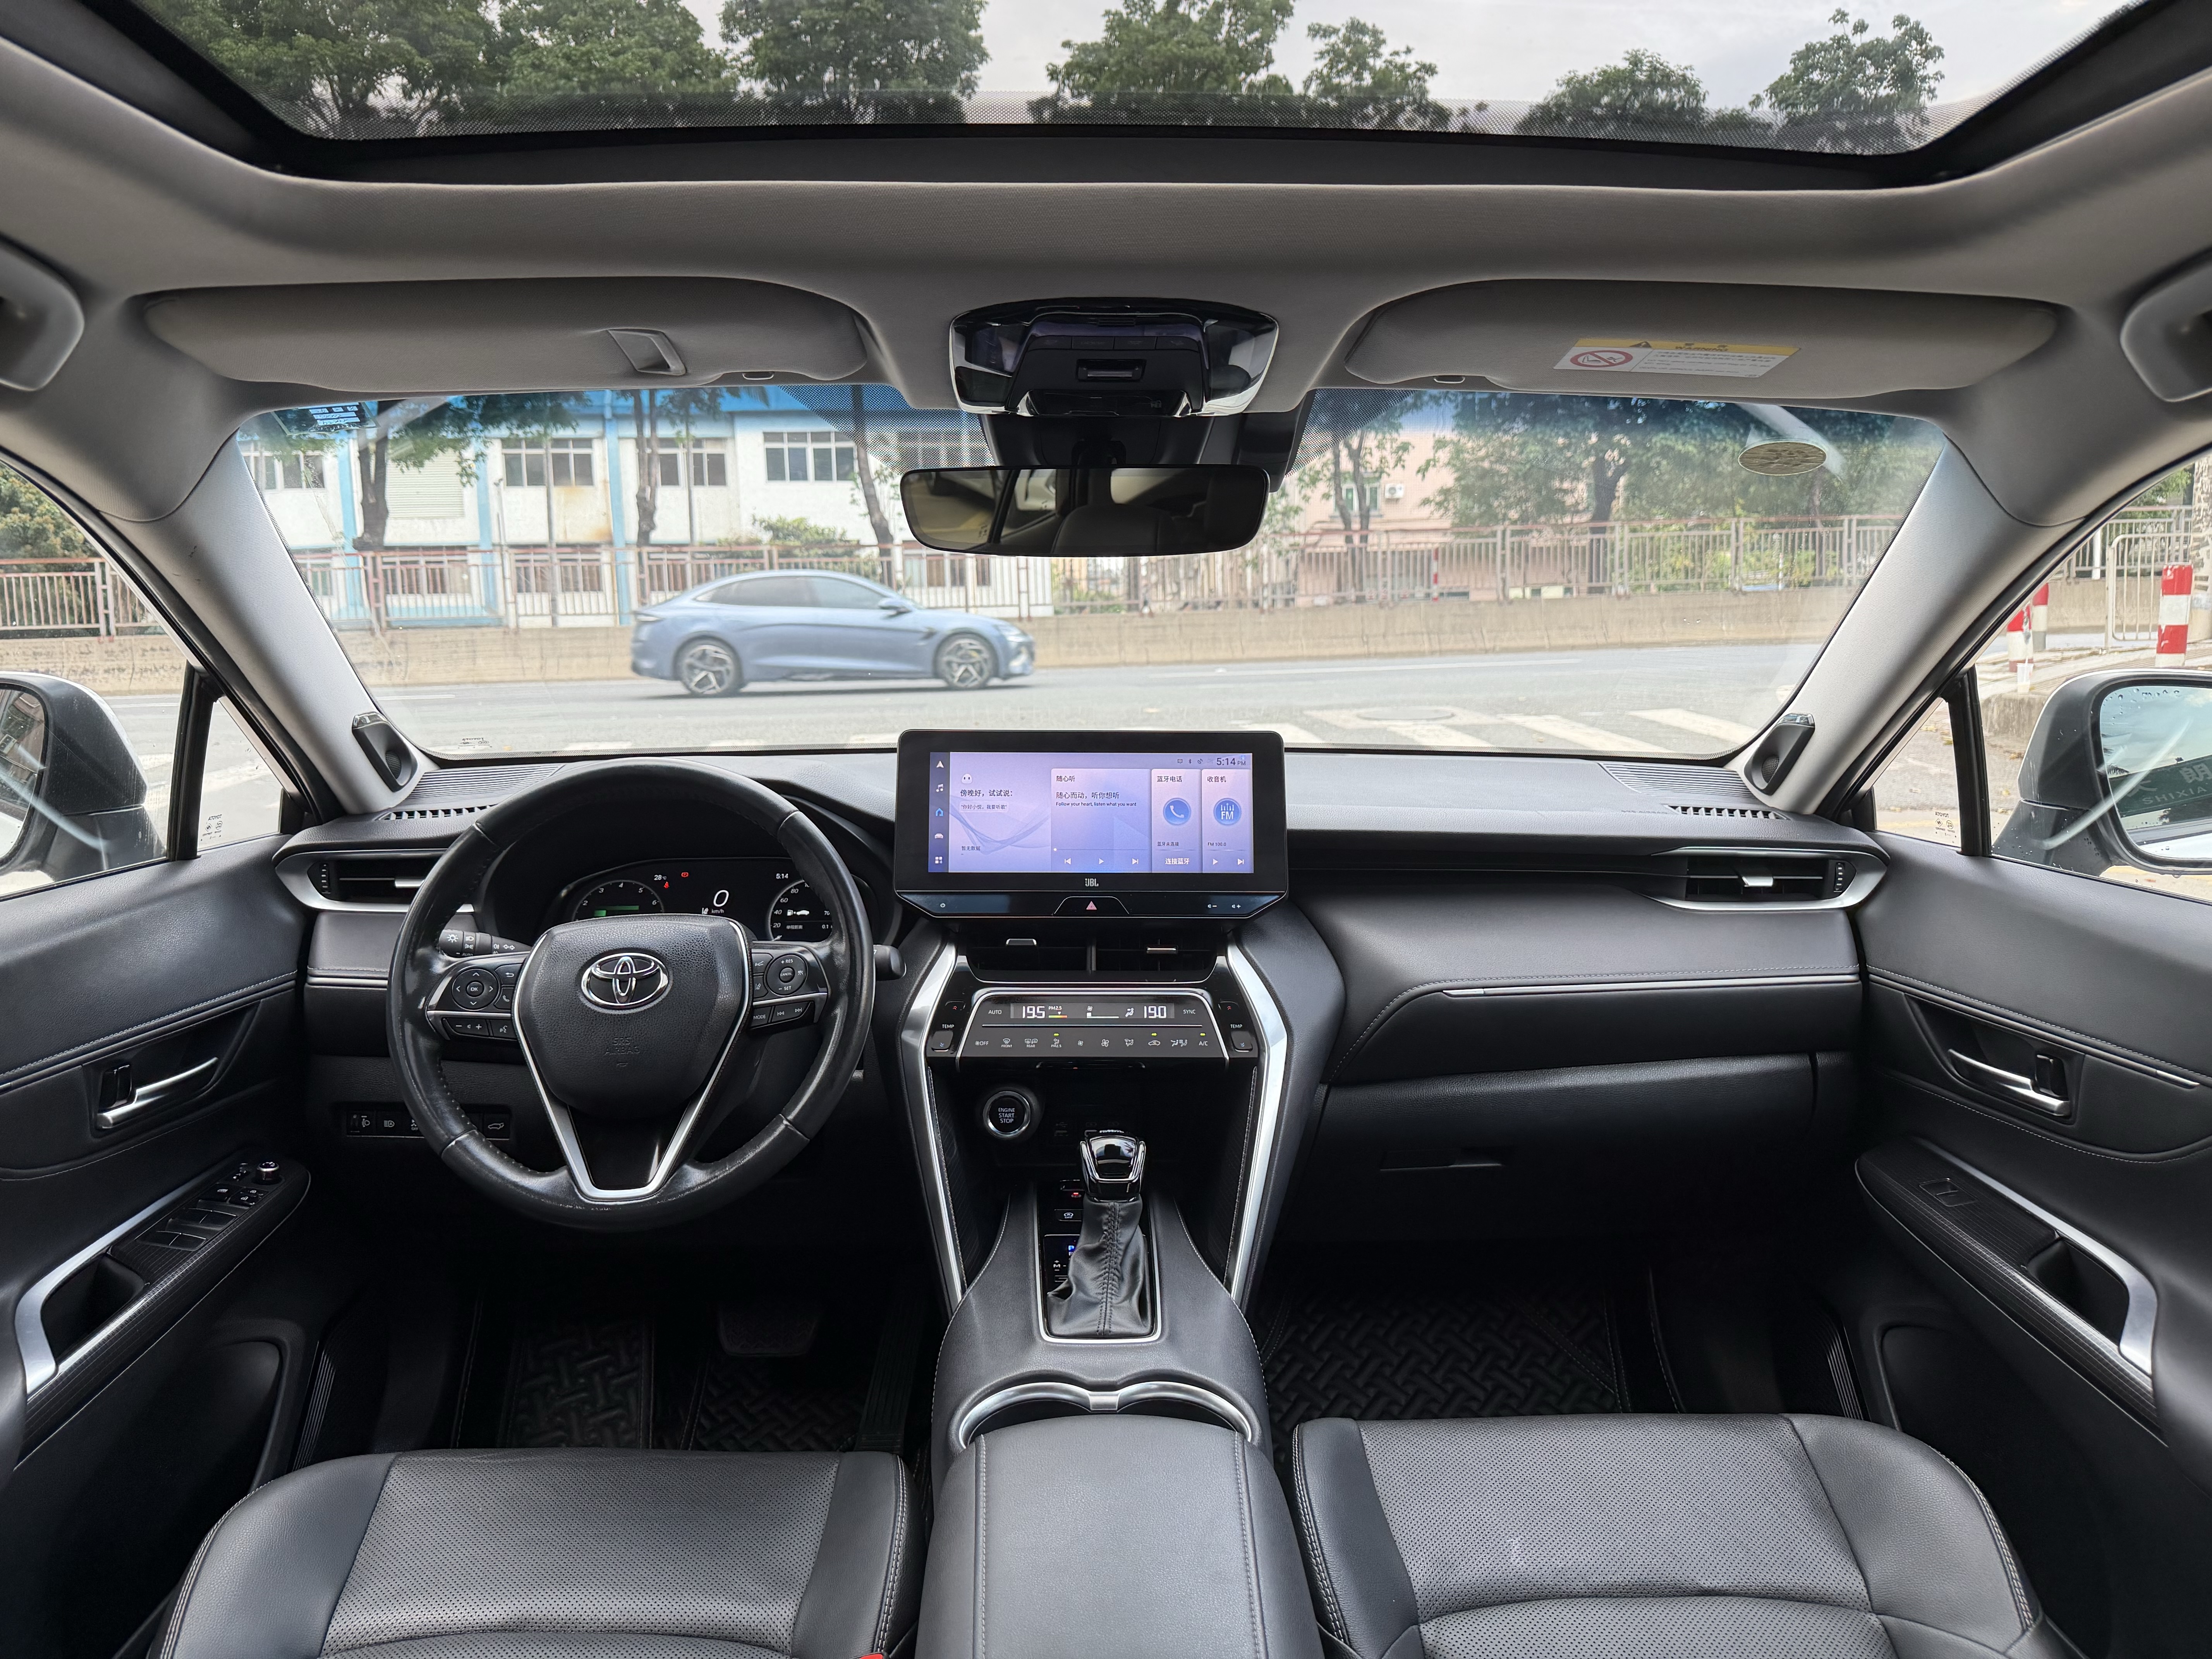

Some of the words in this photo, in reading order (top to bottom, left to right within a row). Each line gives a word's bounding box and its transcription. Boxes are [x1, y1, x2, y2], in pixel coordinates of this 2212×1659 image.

[1216, 757, 1236, 766] 5:14
[2142, 786, 2207, 804] SHIXIA
[1221, 811, 1234, 820] FM
[1085, 878, 1099, 887] JBL
[713, 890, 729, 907] 0
[1022, 1006, 1045, 1018] 19.5
[1144, 1006, 1167, 1018] 19.0
[612, 1037, 632, 1045] SRS
[604, 1046, 641, 1055] AIRBAG
